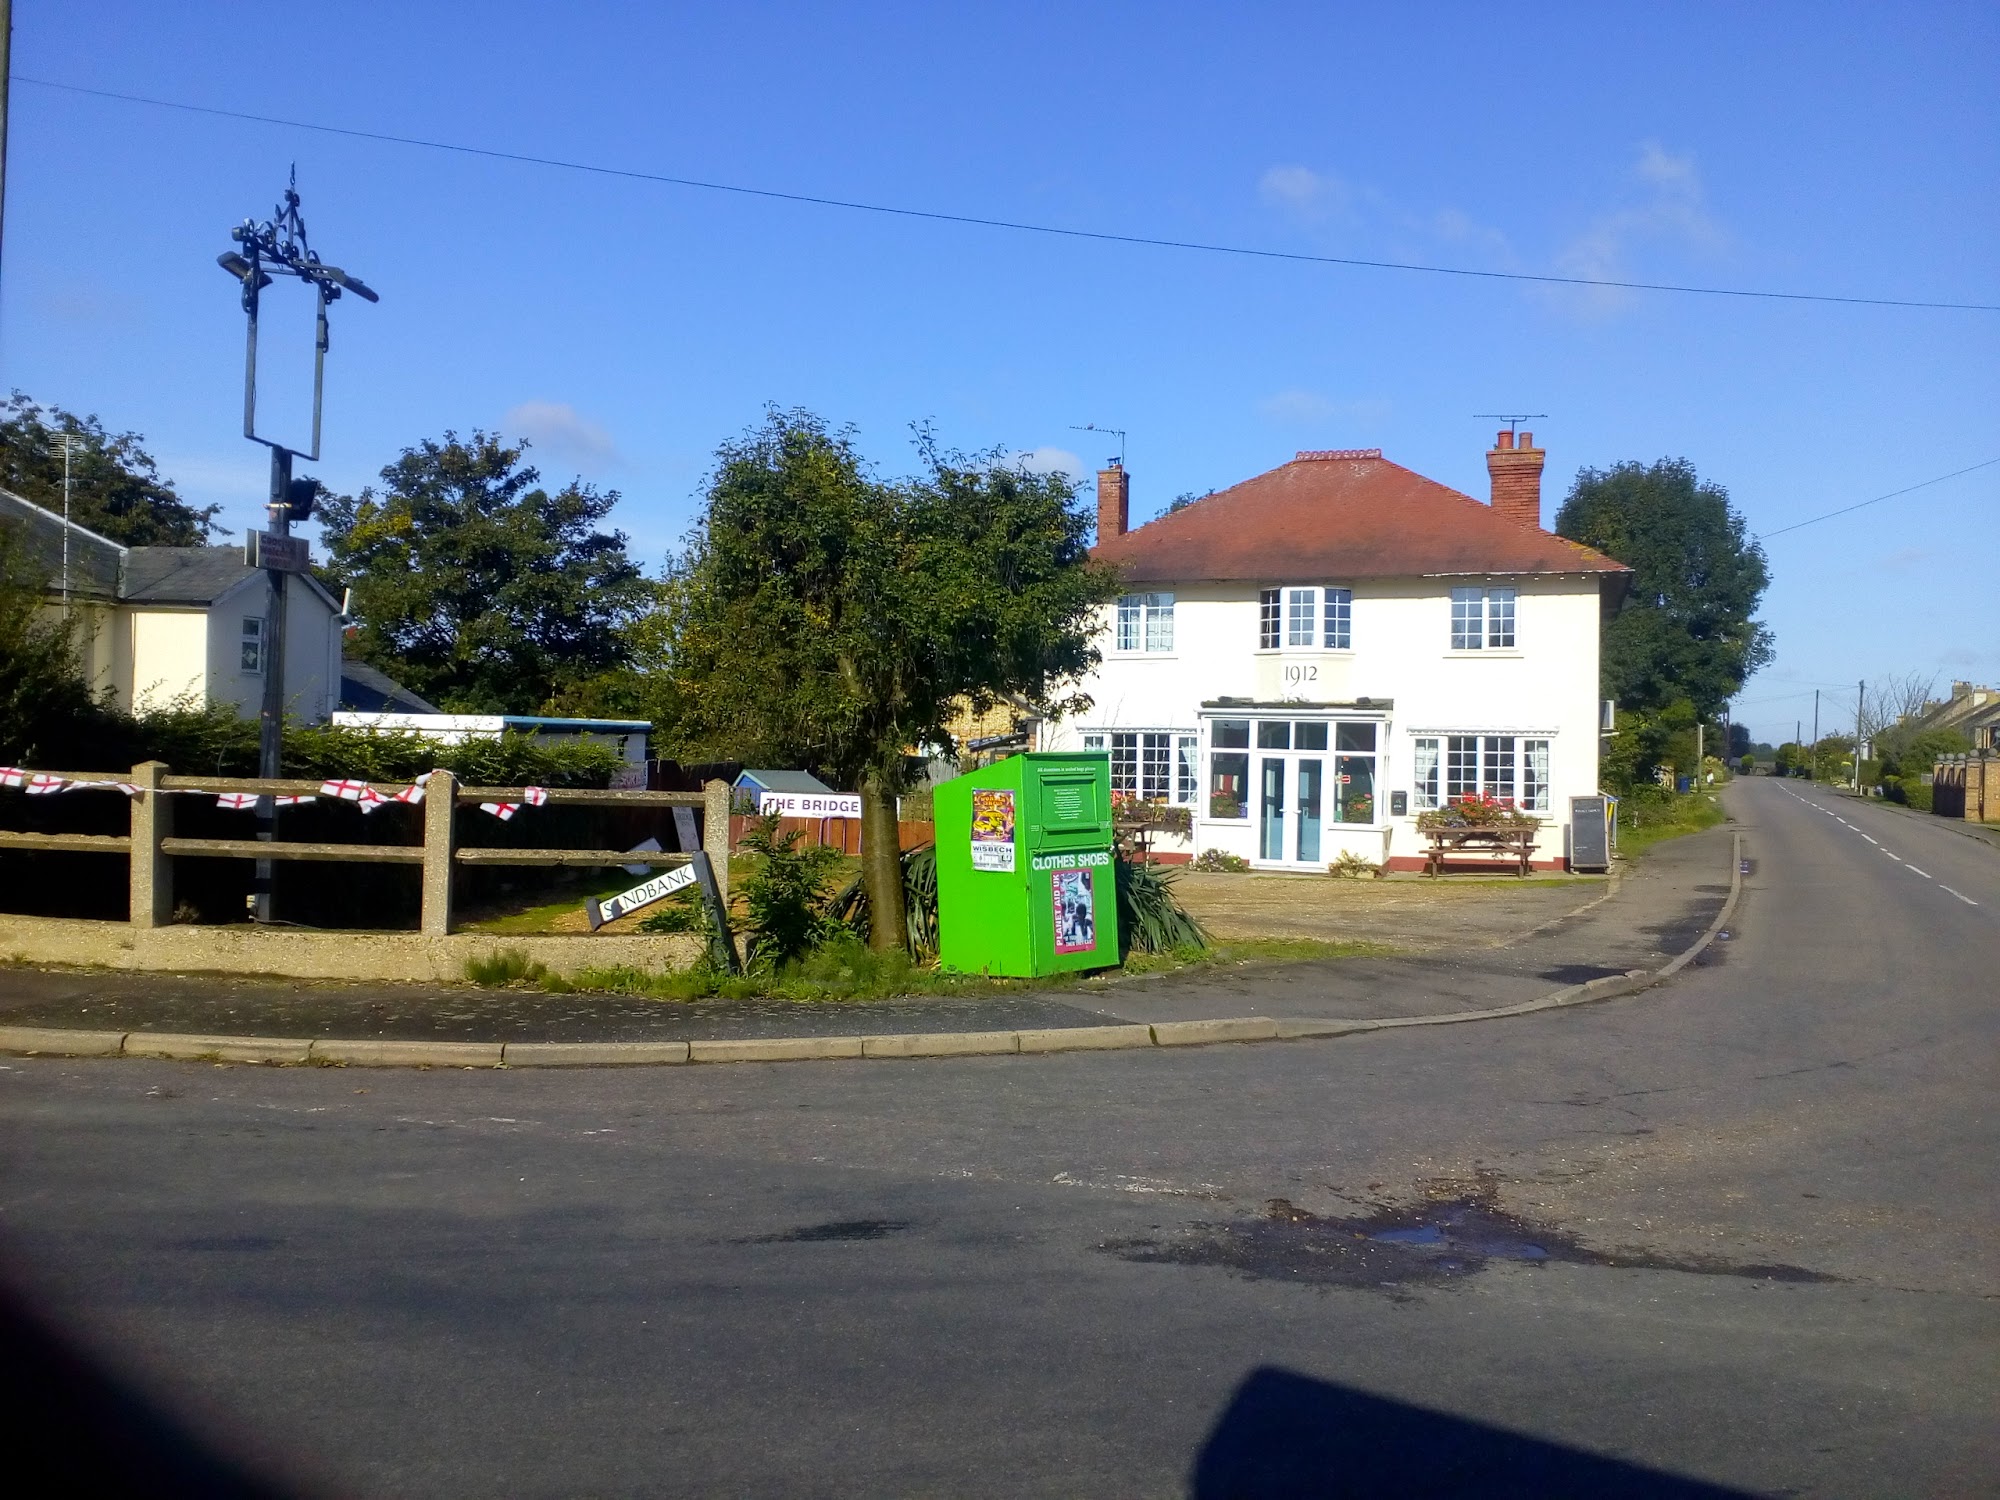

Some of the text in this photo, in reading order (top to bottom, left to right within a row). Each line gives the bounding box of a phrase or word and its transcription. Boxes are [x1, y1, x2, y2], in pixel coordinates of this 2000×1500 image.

[1285, 666, 1317, 687] 1912
[766, 798, 859, 812] THE BRIDGE
[1032, 852, 1109, 870] CLOTHES SHOES
[1053, 874, 1060, 888] UK
[603, 867, 692, 918] SNDBANK
[1055, 910, 1063, 946] PLANET
